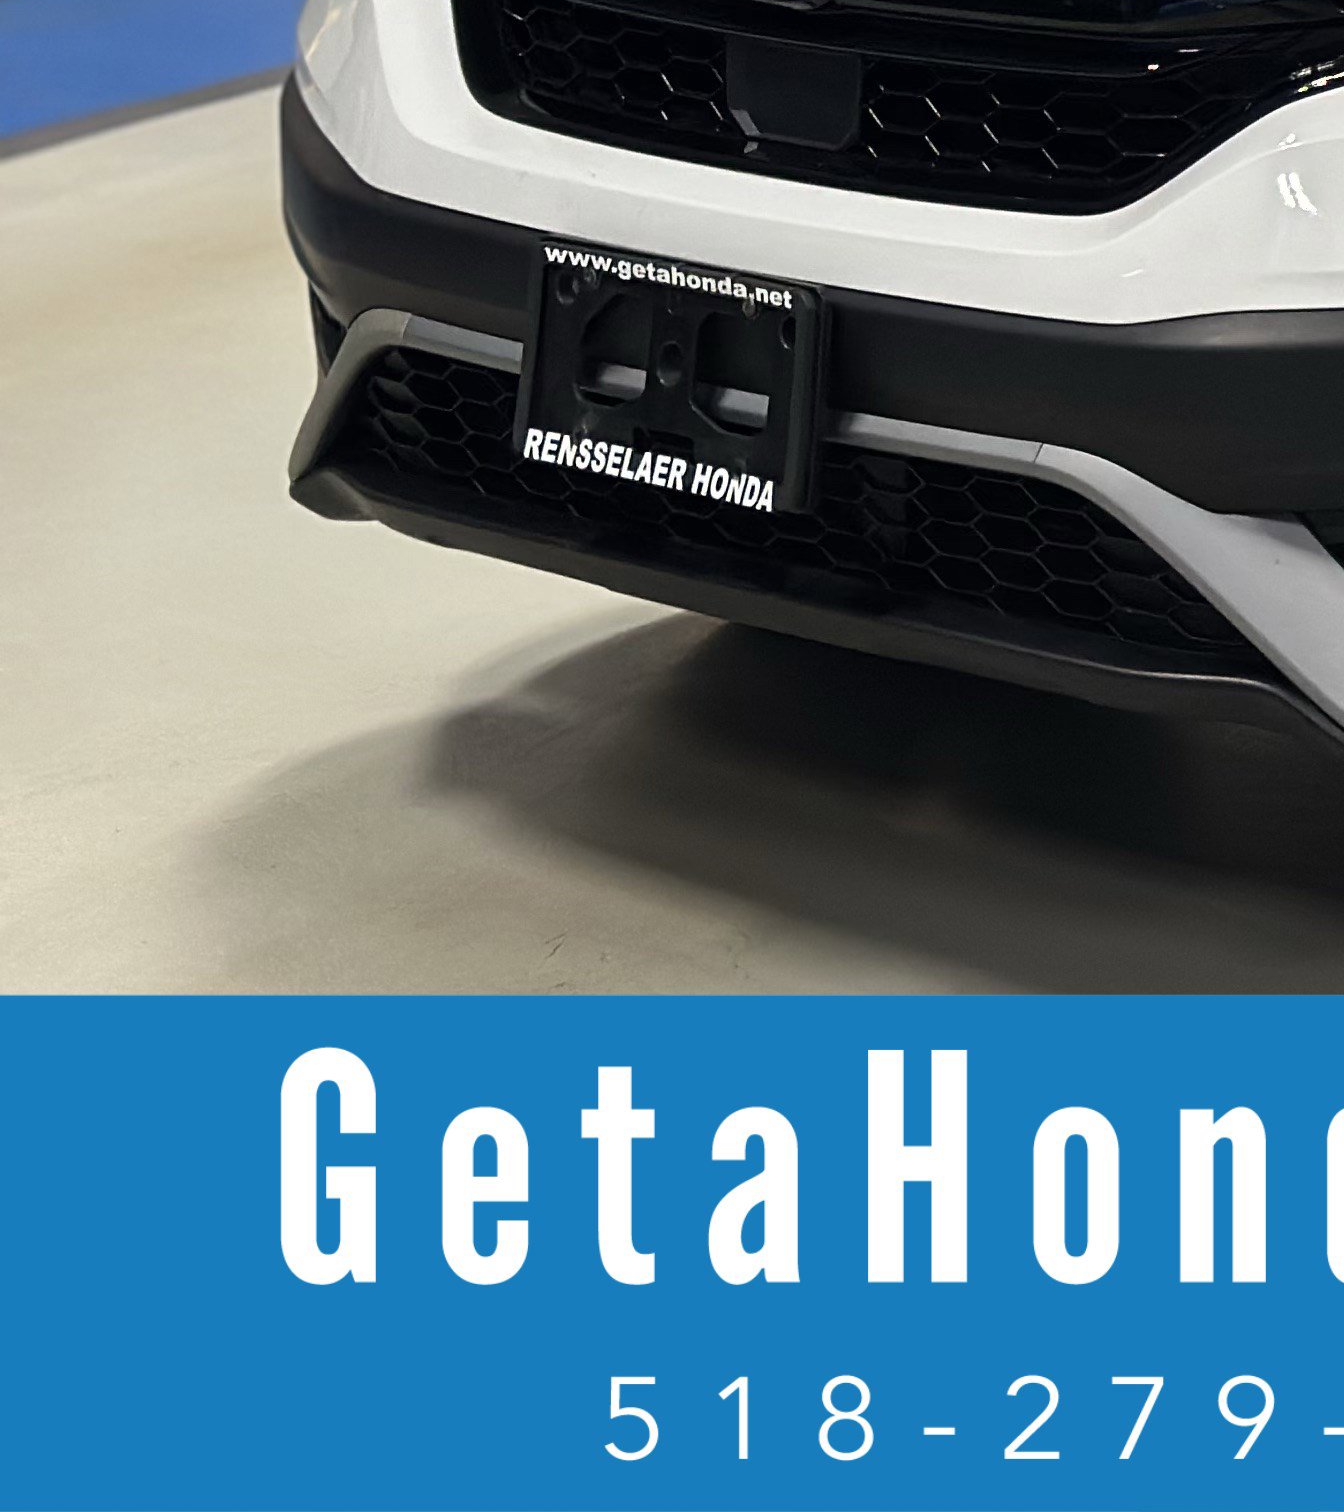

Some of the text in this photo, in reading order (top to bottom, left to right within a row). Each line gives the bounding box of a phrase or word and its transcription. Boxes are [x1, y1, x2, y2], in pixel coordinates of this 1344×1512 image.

[544, 246, 793, 309] www.getahonda.net
[523, 428, 775, 512] RENSSELAER HONDA
